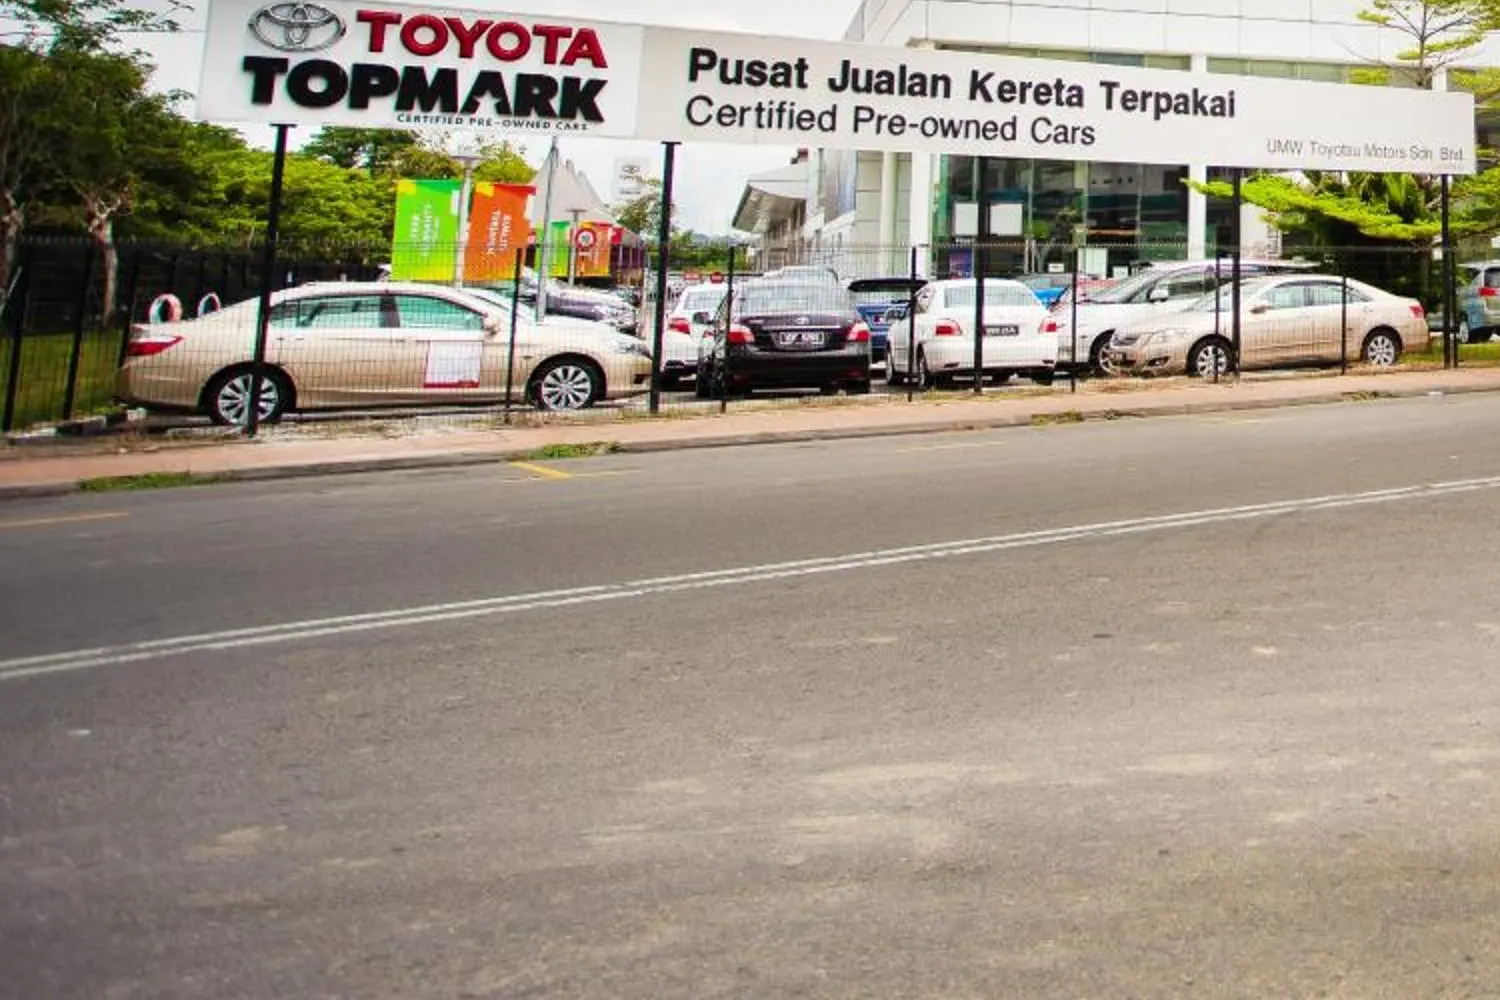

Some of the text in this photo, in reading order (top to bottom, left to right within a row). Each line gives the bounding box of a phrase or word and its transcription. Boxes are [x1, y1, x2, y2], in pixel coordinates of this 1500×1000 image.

[356, 9, 608, 69] TOYOTA
[243, 55, 608, 123] TOPMARK
[688, 47, 1235, 120] Pusat Jualan Kereta Terpakai
[397, 114, 463, 126] CERTIFIED
[469, 117, 551, 130] PRE-OWNED
[685, 95, 1096, 145] Certified Pre-owned Cars
[1267, 139, 1302, 154] UMW
